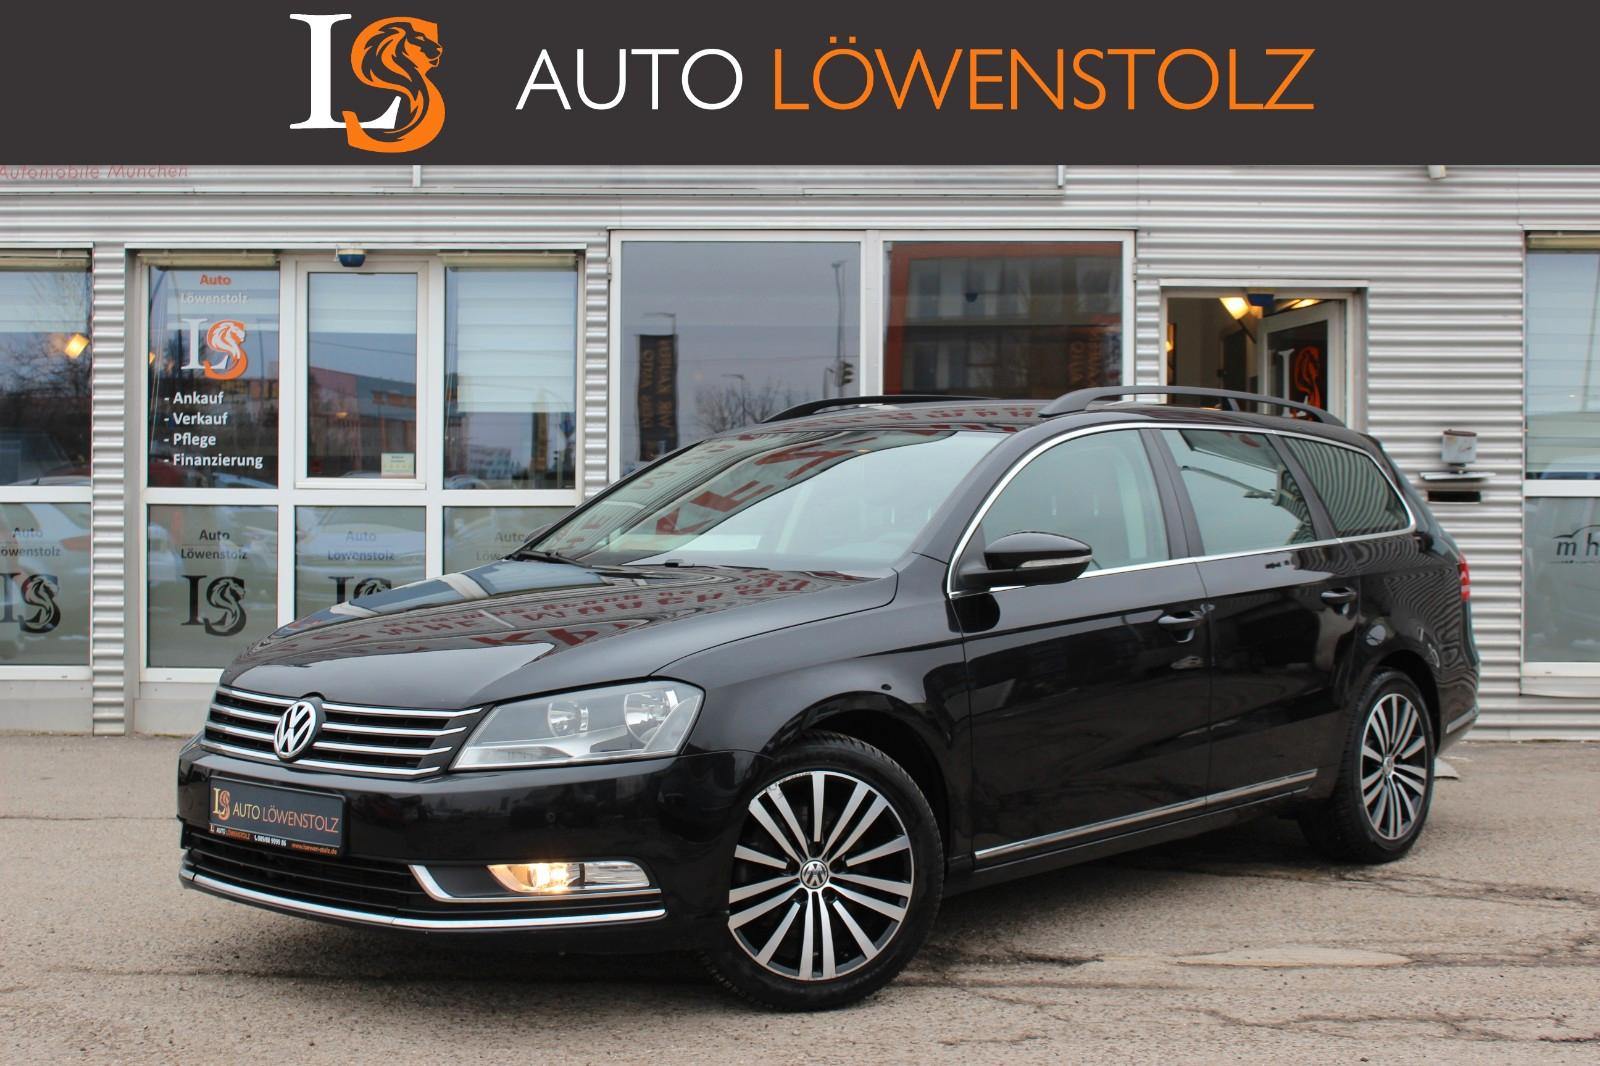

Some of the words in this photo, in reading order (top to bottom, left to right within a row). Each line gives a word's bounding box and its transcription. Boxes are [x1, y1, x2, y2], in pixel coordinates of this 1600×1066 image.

[0, 165, 99, 179] Automobile
[200, 274, 231, 285] Auto
[181, 291, 248, 304] Löwenstolz
[173, 391, 224, 404] Ankauf
[172, 412, 228, 425] Verkauf
[173, 432, 216, 449] Pflege
[173, 453, 263, 469] Finanzierung
[199, 529, 230, 541] Auto
[345, 530, 377, 542] Auto
[0, 545, 61, 557] öwenstolz
[181, 547, 248, 560] Löwenstolz
[232, 802, 261, 821] AUTO
[262, 804, 339, 833] LÖWENSTOLZ
